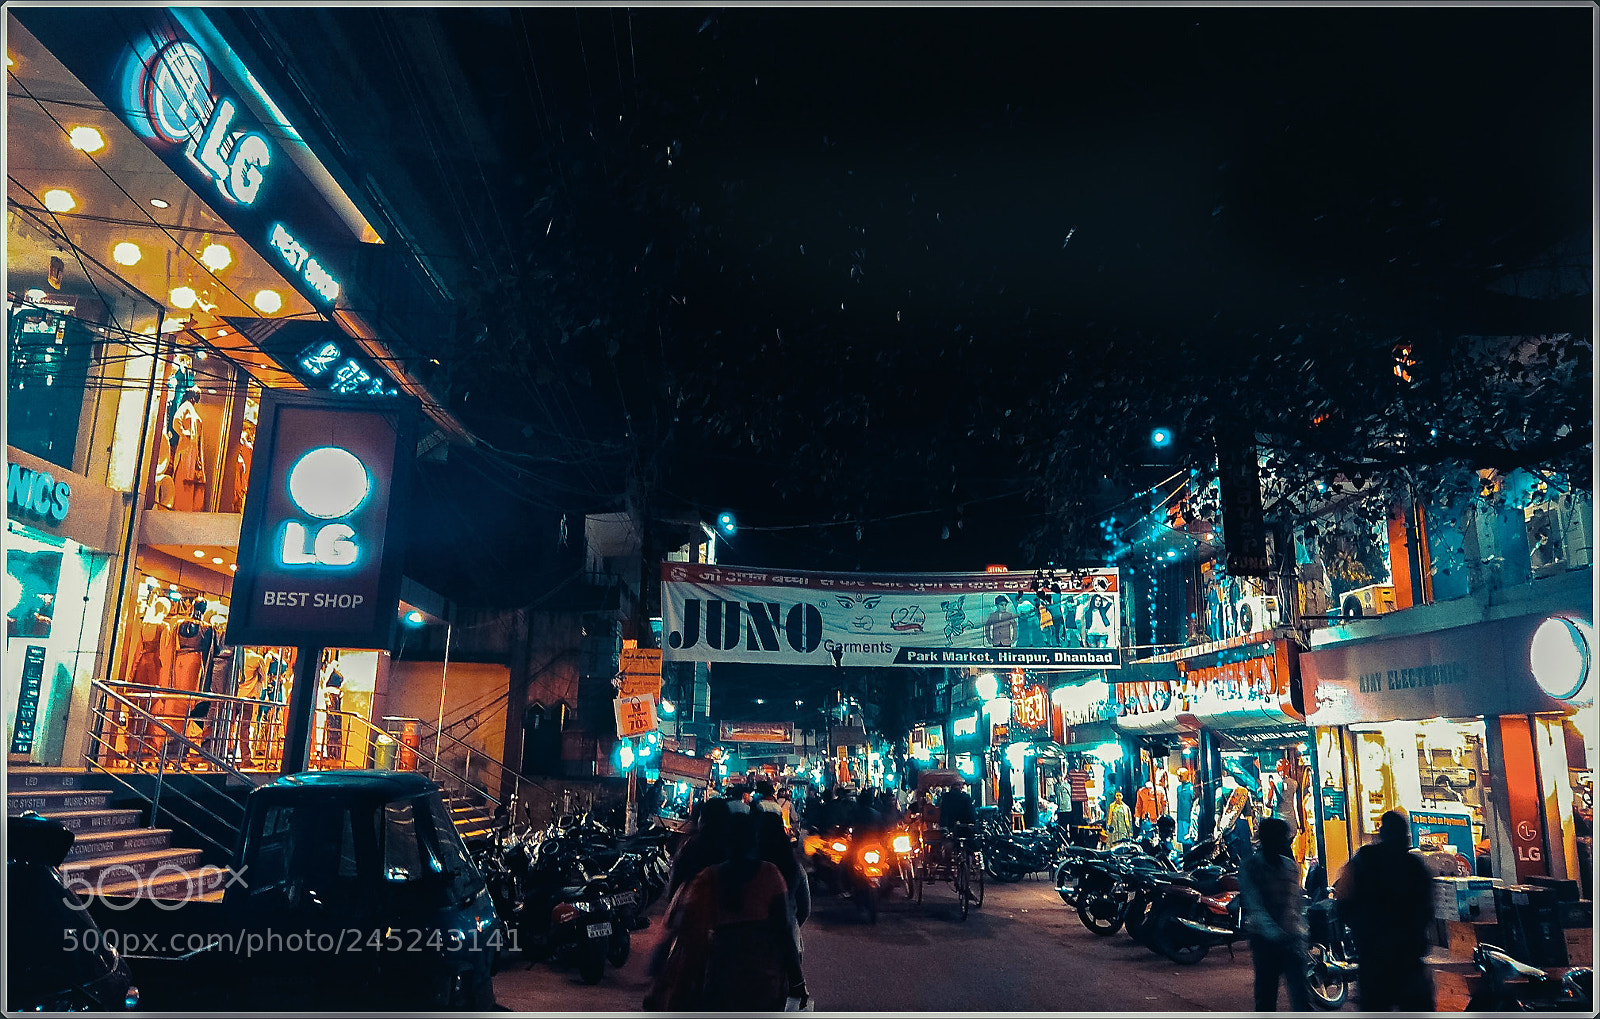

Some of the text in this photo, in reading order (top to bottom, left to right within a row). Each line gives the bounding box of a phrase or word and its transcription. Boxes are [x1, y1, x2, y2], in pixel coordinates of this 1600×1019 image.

[189, 97, 271, 206] LG
[282, 522, 359, 565] LG
[263, 591, 364, 609] BEST SHOP
[668, 598, 822, 654] JUNO
[824, 639, 892, 655] Garments
[907, 651, 1113, 665] Park Market, Hirapur, Dhanbad
[19, 798, 46, 809] SYSTEM
[1518, 846, 1541, 861] LG
